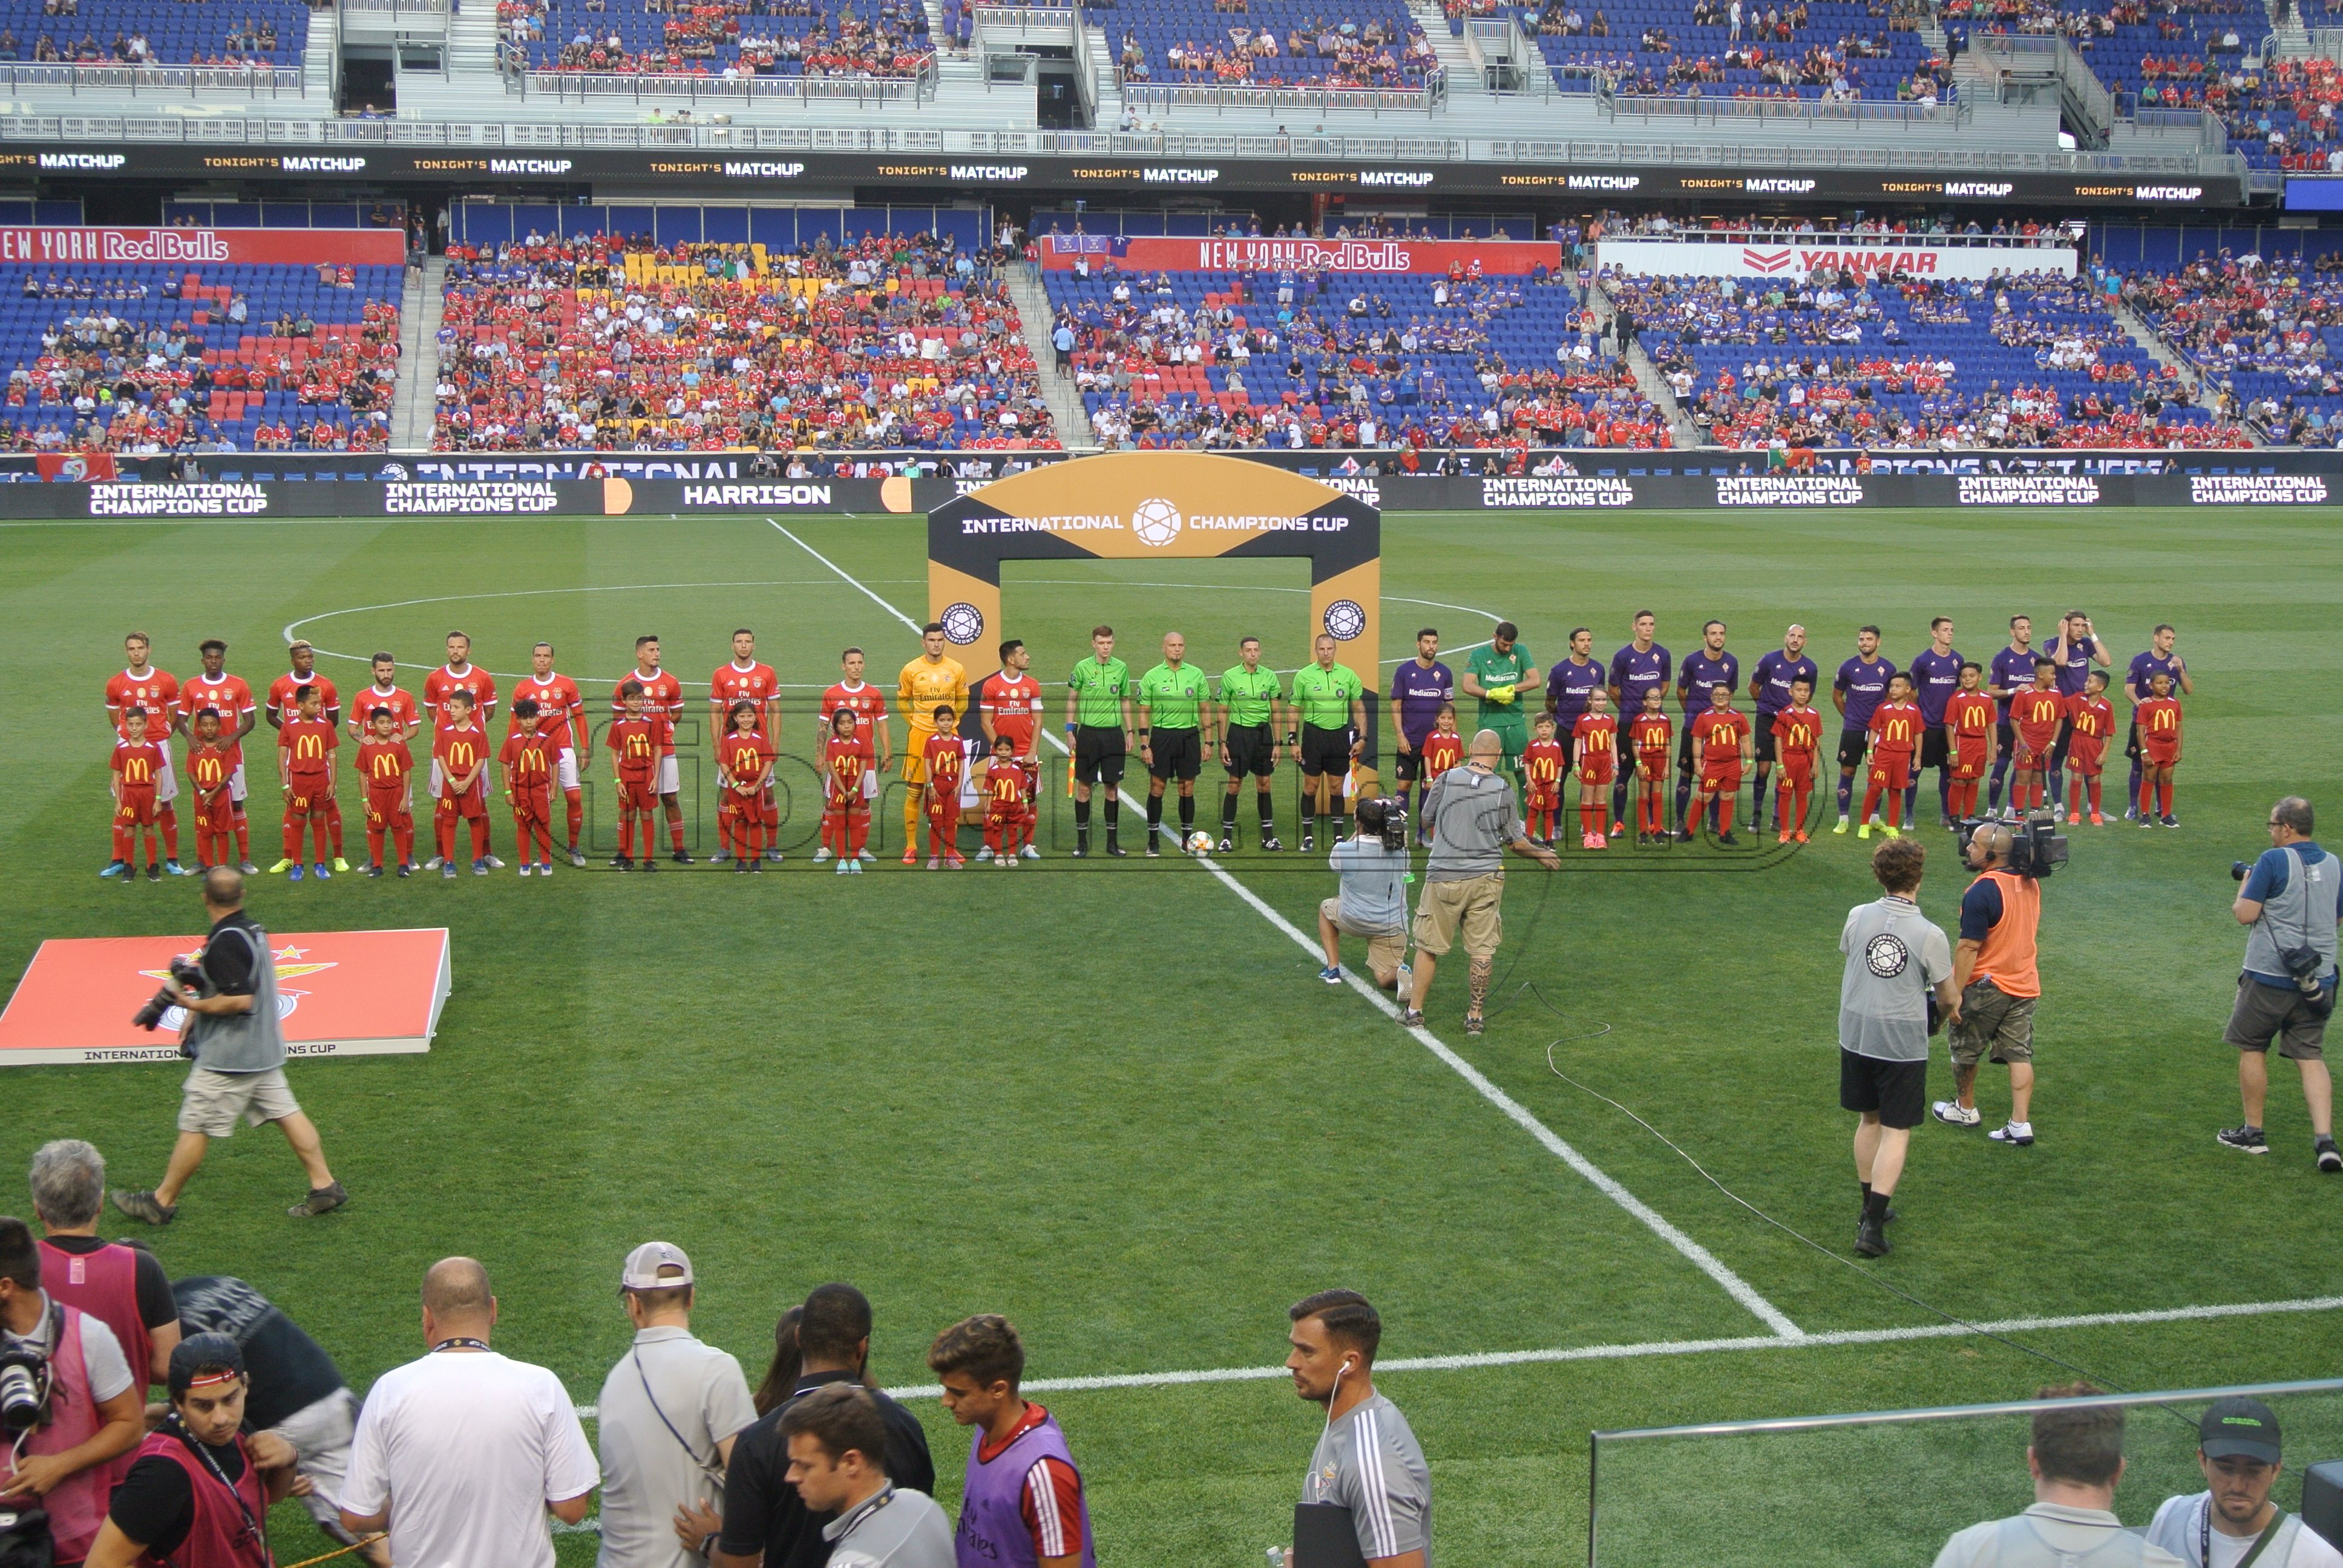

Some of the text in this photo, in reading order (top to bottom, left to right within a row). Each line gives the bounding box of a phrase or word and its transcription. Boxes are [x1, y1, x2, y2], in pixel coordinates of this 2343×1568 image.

[41, 154, 125, 168] MATCHUP
[204, 157, 365, 171] TONIGHT'S MATCHUP
[414, 159, 572, 173] TONIGHT'S MATCHUP
[650, 162, 804, 176] TONIGHT'S MATCHUP
[877, 166, 1027, 179] TONIGHT'S MATCHUP
[1072, 168, 1219, 183] TONIGHT'S MATCHUP
[1291, 172, 1434, 185] TONIGHT'S MATCHUP
[1501, 175, 1639, 189] TONIGHT'S MATCHUP
[1680, 178, 1815, 192] TONIGHT'S MATCHUP
[1882, 183, 2013, 195] TONIGHT'S MATCHUP
[2074, 186, 2202, 198] TONIGHT'S MATCHUP
[41, 232, 97, 259] YORK
[1200, 242, 1238, 269] NEW
[1247, 242, 1296, 270] YORK
[1800, 250, 1938, 273] YANMAR
[387, 482, 557, 498] INTERNATIONAL
[1483, 479, 1632, 492] INTERNATIONAL
[1716, 477, 1862, 491] INTERNATIONAL
[1958, 476, 2099, 491] INTERNATIONAL
[2191, 476, 2326, 490] INTERNATIONAL
[91, 484, 267, 499] INTERNATIONAL
[684, 485, 831, 505] HARRISON
[1717, 490, 1863, 505] CHAMPIONS CUP
[1959, 490, 2100, 503] CHAMPIONS CUP
[2192, 489, 2327, 503] CHAMPIONS CUP
[91, 498, 267, 514] CHAMPIONS CUP
[386, 497, 557, 512] CHAMPIONS CUP
[1484, 492, 1633, 506] CHAMPIONS CUP
[962, 514, 1349, 534] INTERNATIONAL CHAMPIONS CUP
[942, 604, 981, 622] INTERNATIONAL
[1325, 601, 1364, 619] INTERNATIONAL
[1325, 622, 1364, 640] CHAMPIONS CUP
[1485, 673, 1515, 682] Mediacom
[1629, 673, 1657, 681] Mediacom
[920, 692, 951, 702] Emirates
[1409, 688, 1438, 697] Mediacom
[998, 707, 1029, 715] Emirates
[1868, 935, 1907, 957] INTERNATIONAL
[1867, 955, 1906, 976] CHAMPIONS CUP
[310, 1044, 336, 1054] CUP
